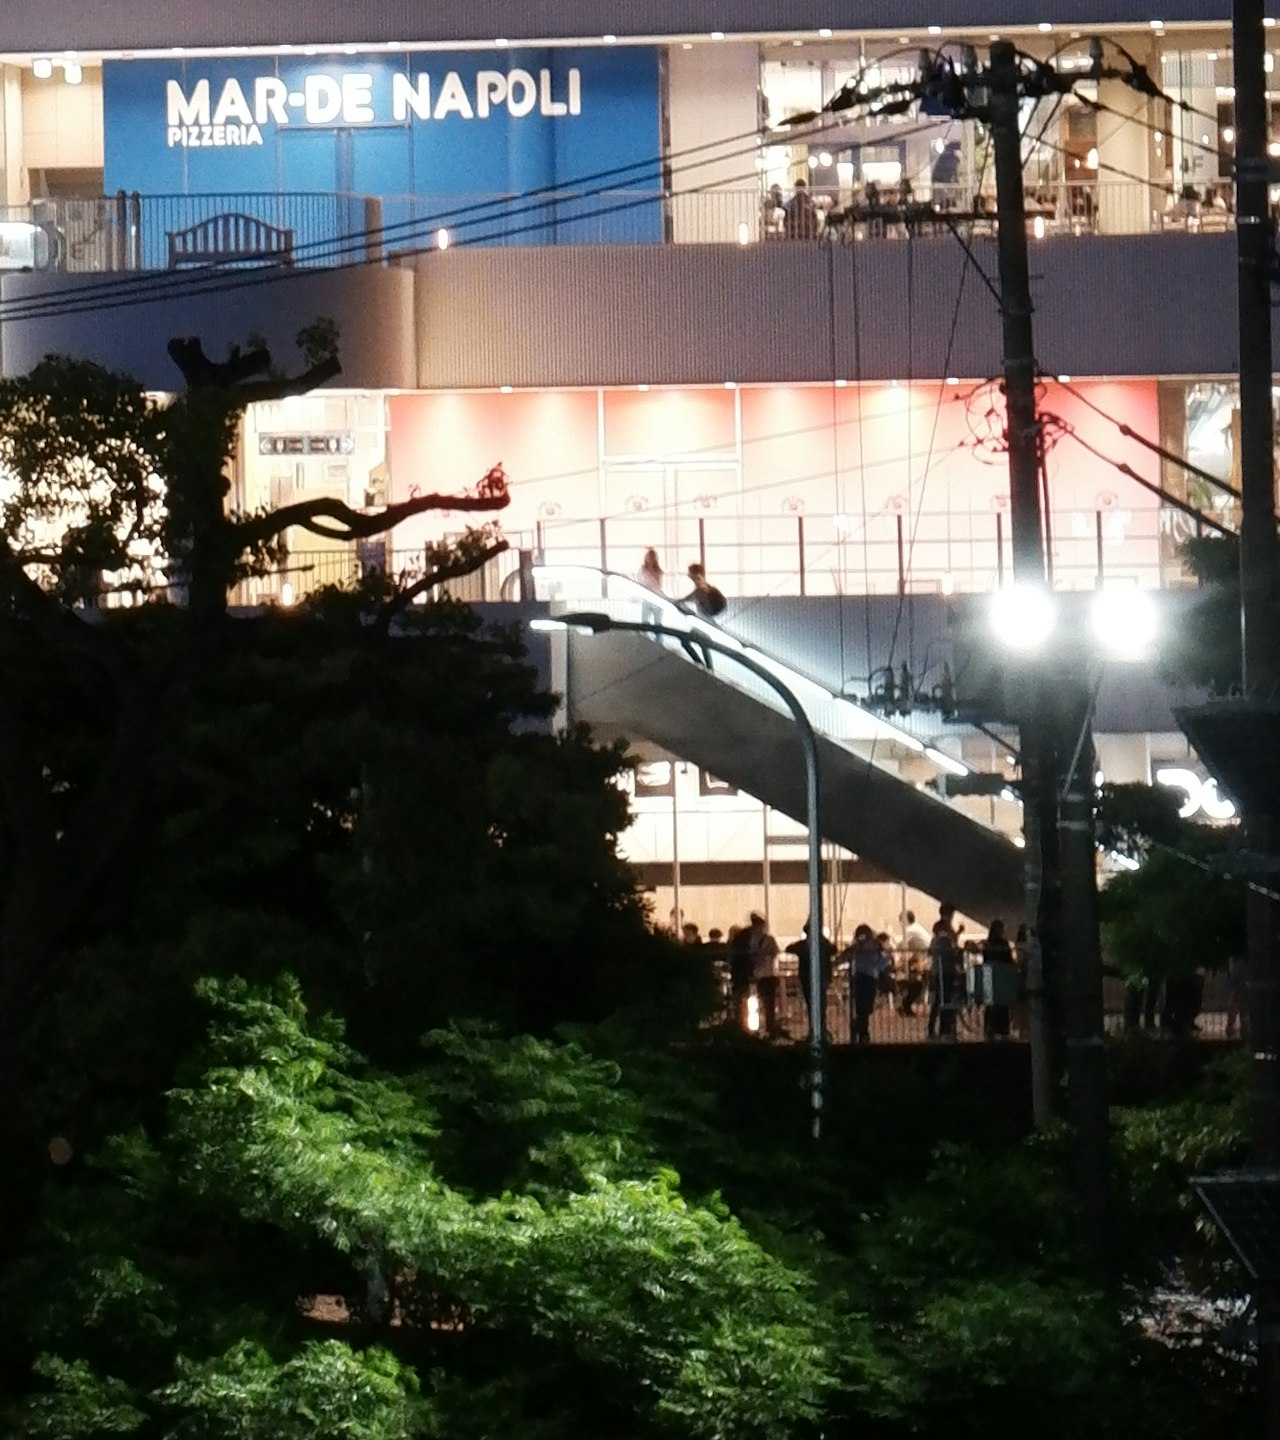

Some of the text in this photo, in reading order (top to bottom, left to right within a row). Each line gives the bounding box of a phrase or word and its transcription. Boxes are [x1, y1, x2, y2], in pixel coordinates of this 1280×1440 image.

[167, 67, 582, 126] MAR-DE NAPOLI
[167, 123, 264, 148] PIZZERIA
